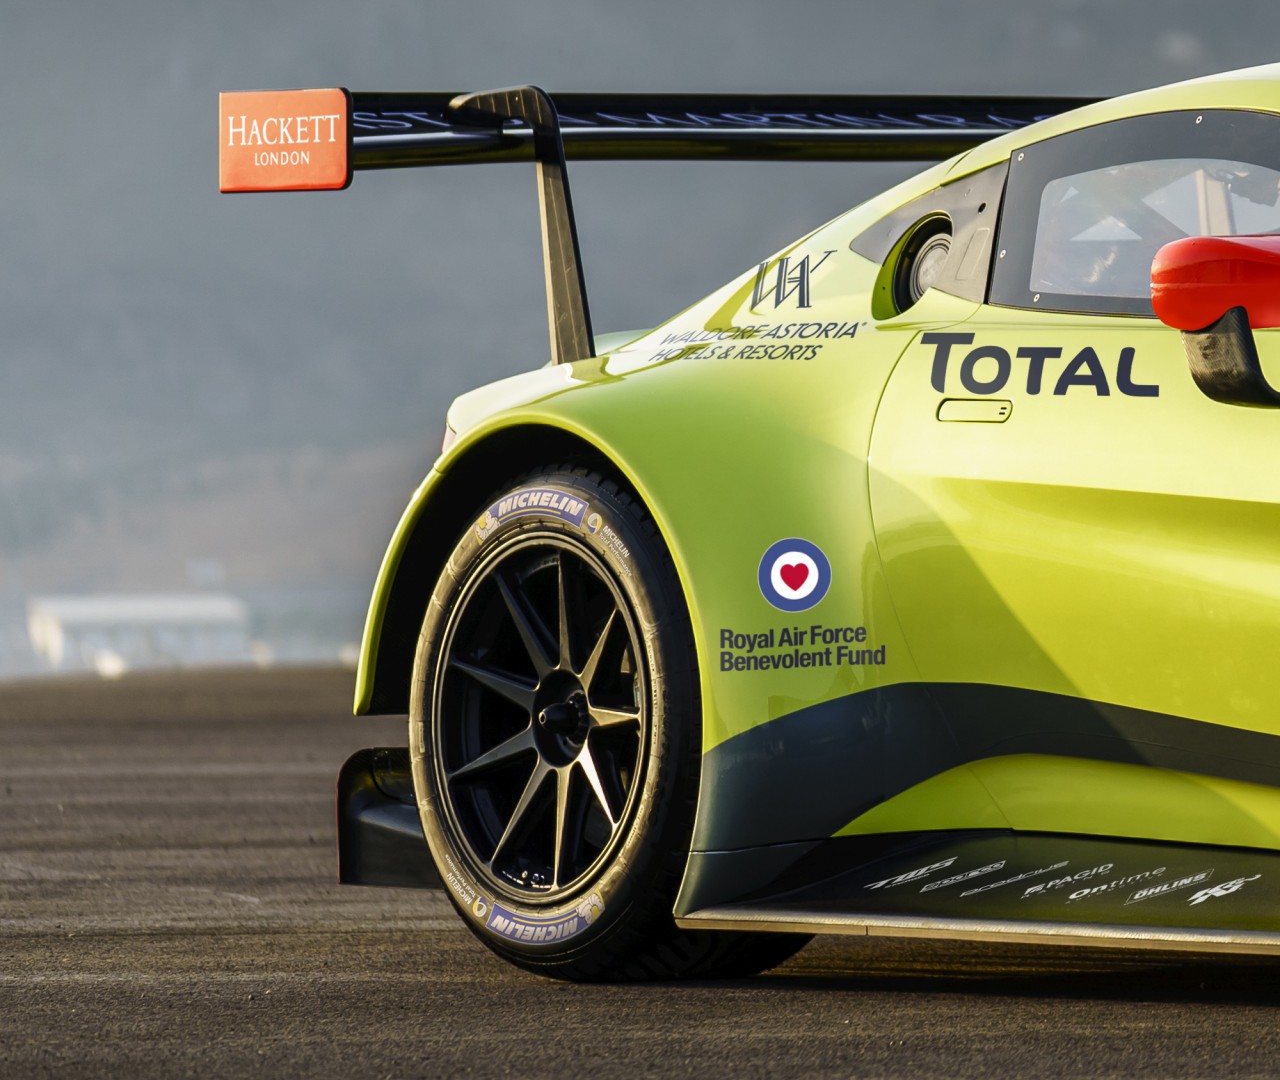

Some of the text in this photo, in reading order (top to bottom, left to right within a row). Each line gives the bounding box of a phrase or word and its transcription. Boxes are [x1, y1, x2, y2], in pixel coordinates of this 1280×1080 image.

[227, 114, 340, 146] HACKETT
[254, 150, 311, 167] LONDON
[659, 321, 860, 346] WALDORF ASTORIA
[648, 344, 823, 362] HOTELS & RESORTS
[920, 332, 1160, 398] TOTAL
[498, 491, 584, 517] MICHELIN
[599, 532, 611, 545] Total
[602, 524, 630, 558] MICHELIN
[719, 625, 867, 653] Royal Air Force
[719, 645, 886, 673] Benevolent Fund
[446, 872, 473, 905] MICHELIN
[1046, 863, 1114, 889] PAGID
[1132, 872, 1208, 900] ÖHLINS
[465, 884, 477, 898] Total
[490, 914, 579, 941] MICHELIN
